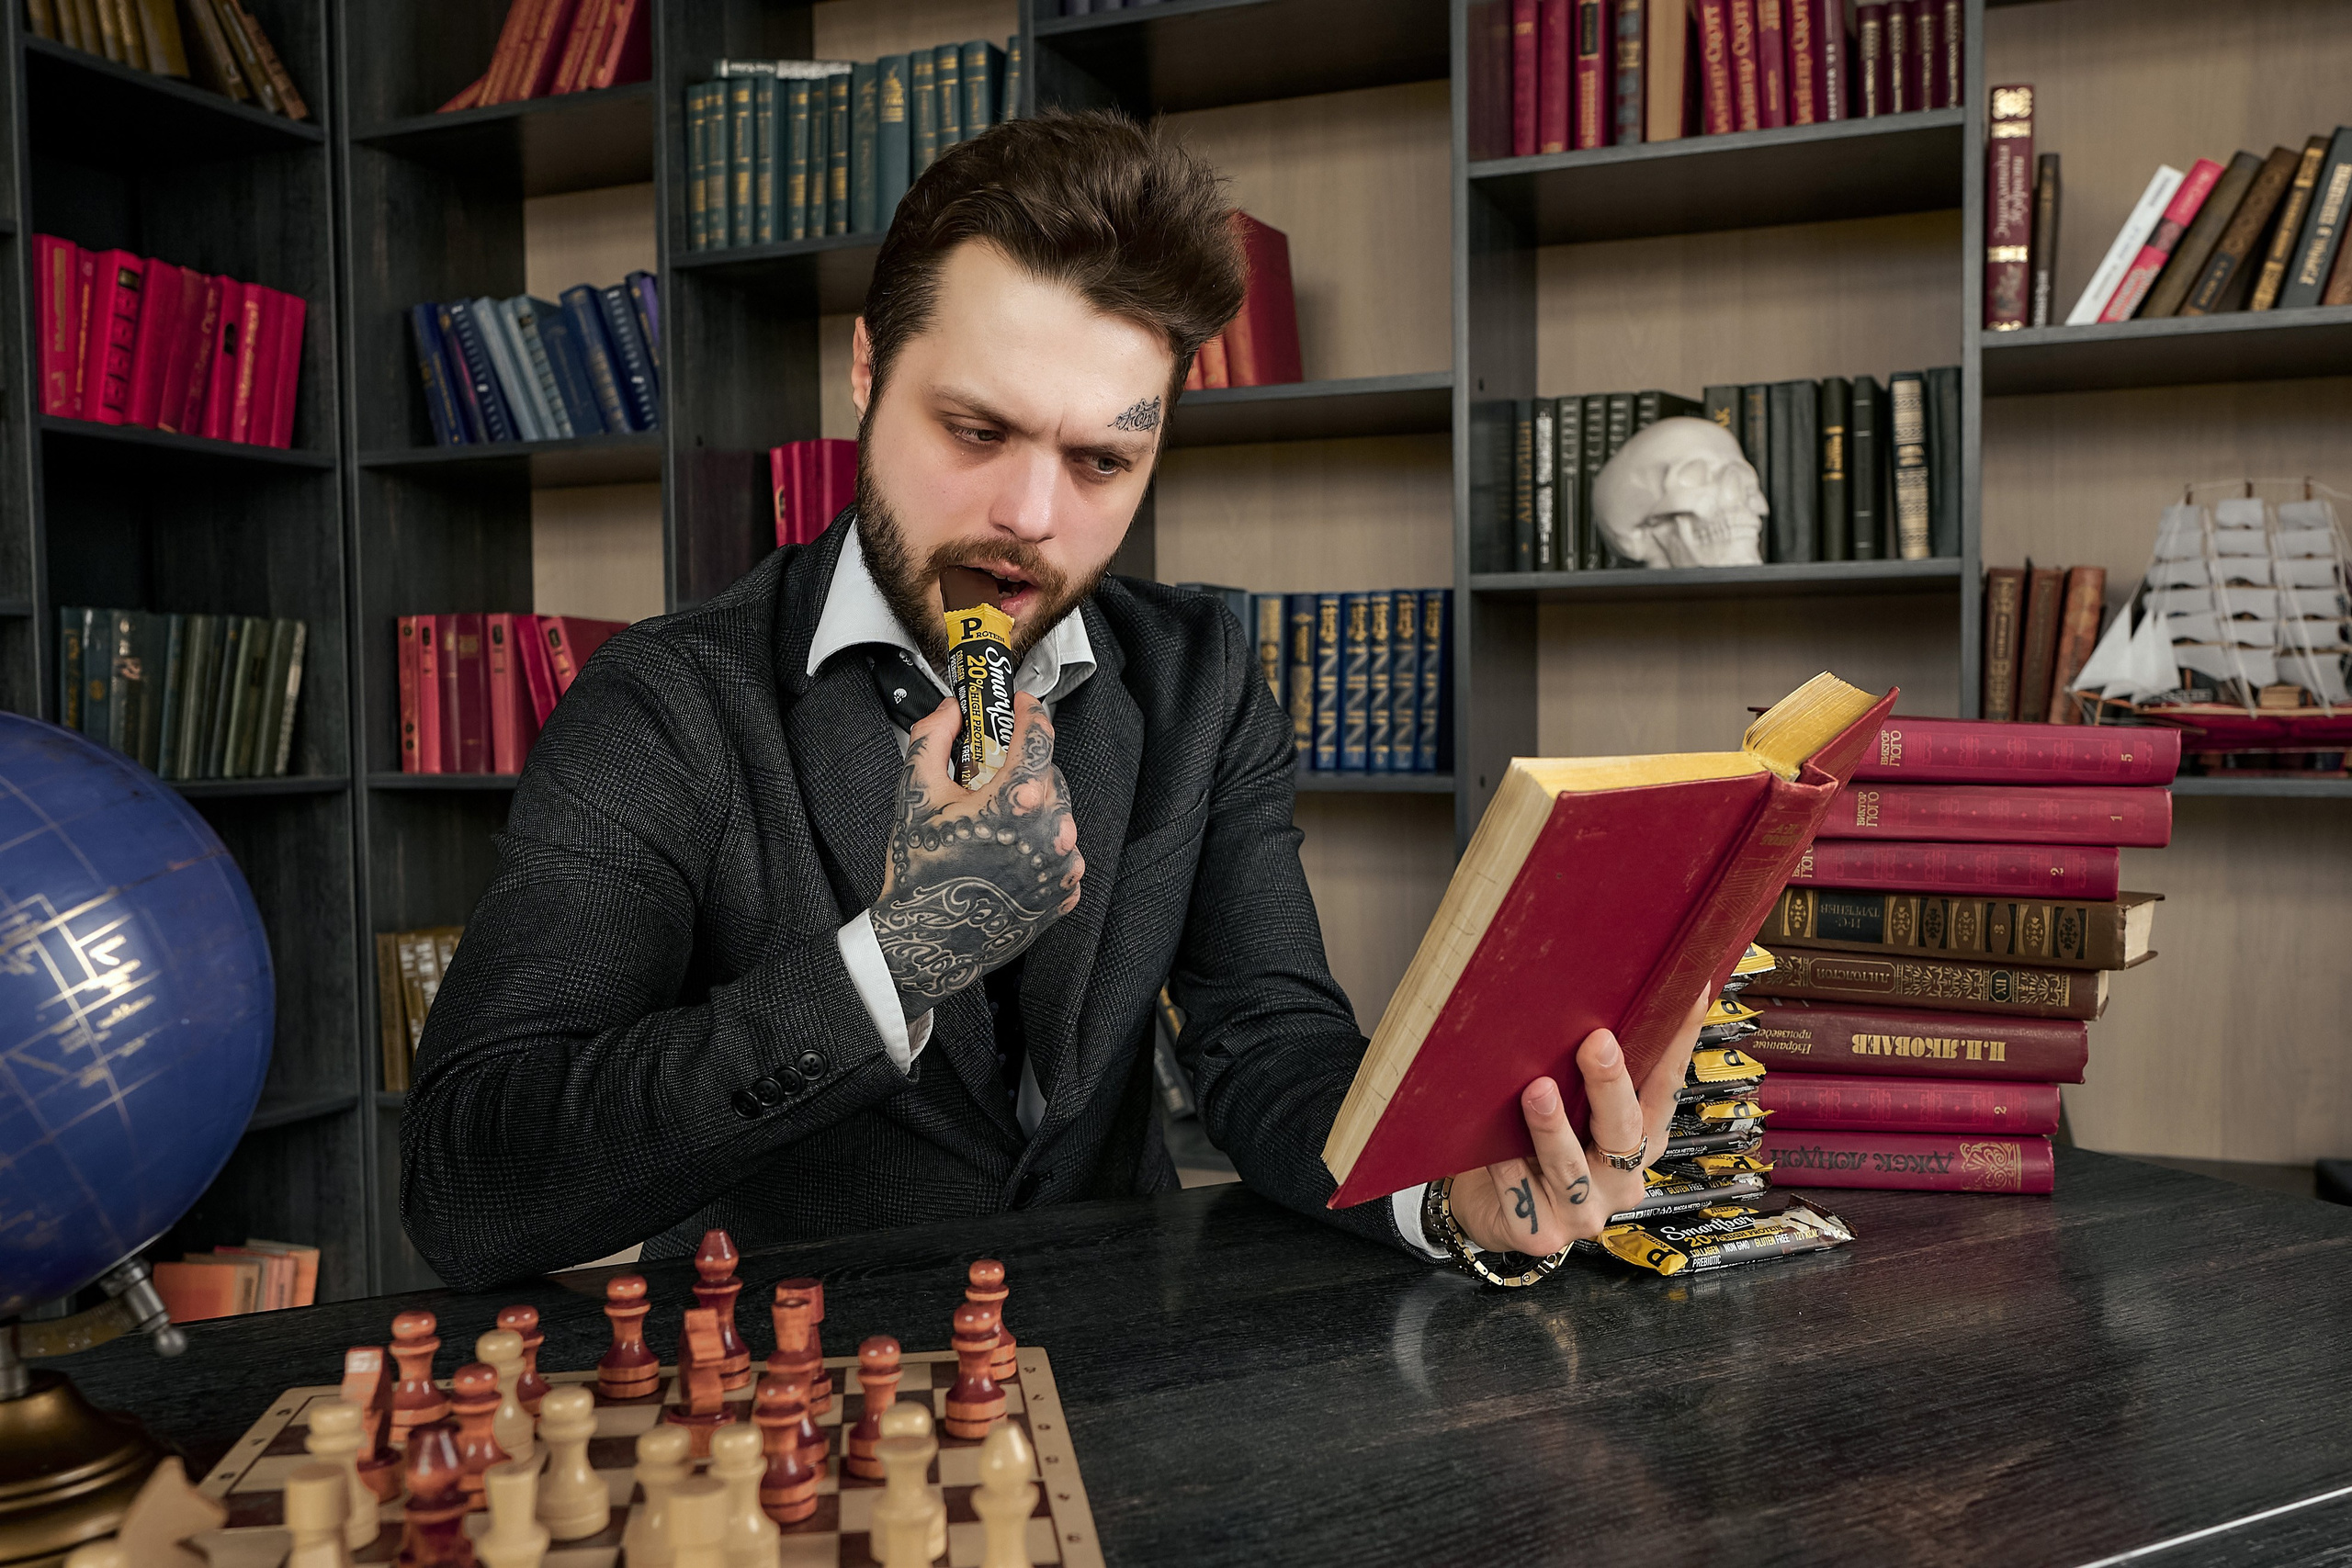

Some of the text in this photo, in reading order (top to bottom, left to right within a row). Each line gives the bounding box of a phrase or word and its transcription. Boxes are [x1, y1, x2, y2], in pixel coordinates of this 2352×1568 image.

[956, 649, 966, 682] COLLAGEN
[967, 654, 988, 693] 20%
[958, 685, 967, 701] NON
[970, 692, 984, 764] HIGH PROTEIN
[961, 744, 970, 763] FREE
[1880, 729, 1889, 765] ВИКТОР
[1890, 729, 1902, 767] ГЮГО
[2121, 753, 2132, 762] 5
[961, 769, 971, 783] 121
[1857, 791, 1866, 827] ВИКТОР
[1866, 791, 1879, 828] ГЮГО
[2110, 814, 2121, 822] 1
[2051, 866, 2064, 877] 2
[1819, 902, 1880, 918] ТУРГЕНЕВ
[1996, 978, 2007, 995] XII
[1752, 1027, 1813, 1041] произведен
[1752, 1039, 1813, 1055] Избранные
[1995, 1105, 2007, 1115] 2
[1769, 1147, 1955, 1175] ДЖЕК ЛОНДОН
[1649, 1188, 1664, 1197] GMO
[1667, 1184, 1690, 1195] GLUTEN
[1690, 1182, 1704, 1192] FREE
[1660, 1215, 1754, 1241] Smartbar
[1684, 1224, 1784, 1247] 20% HIGH PROTEIN
[1690, 1245, 1721, 1258] COLLAGEN
[1723, 1242, 1737, 1253] NON
[1736, 1239, 1750, 1250] GMO
[1755, 1235, 1775, 1247] GLUTEN
[1775, 1233, 1791, 1245] FREE
[1793, 1231, 1805, 1241] 121
[1691, 1254, 1722, 1269] PREBIOTIC
